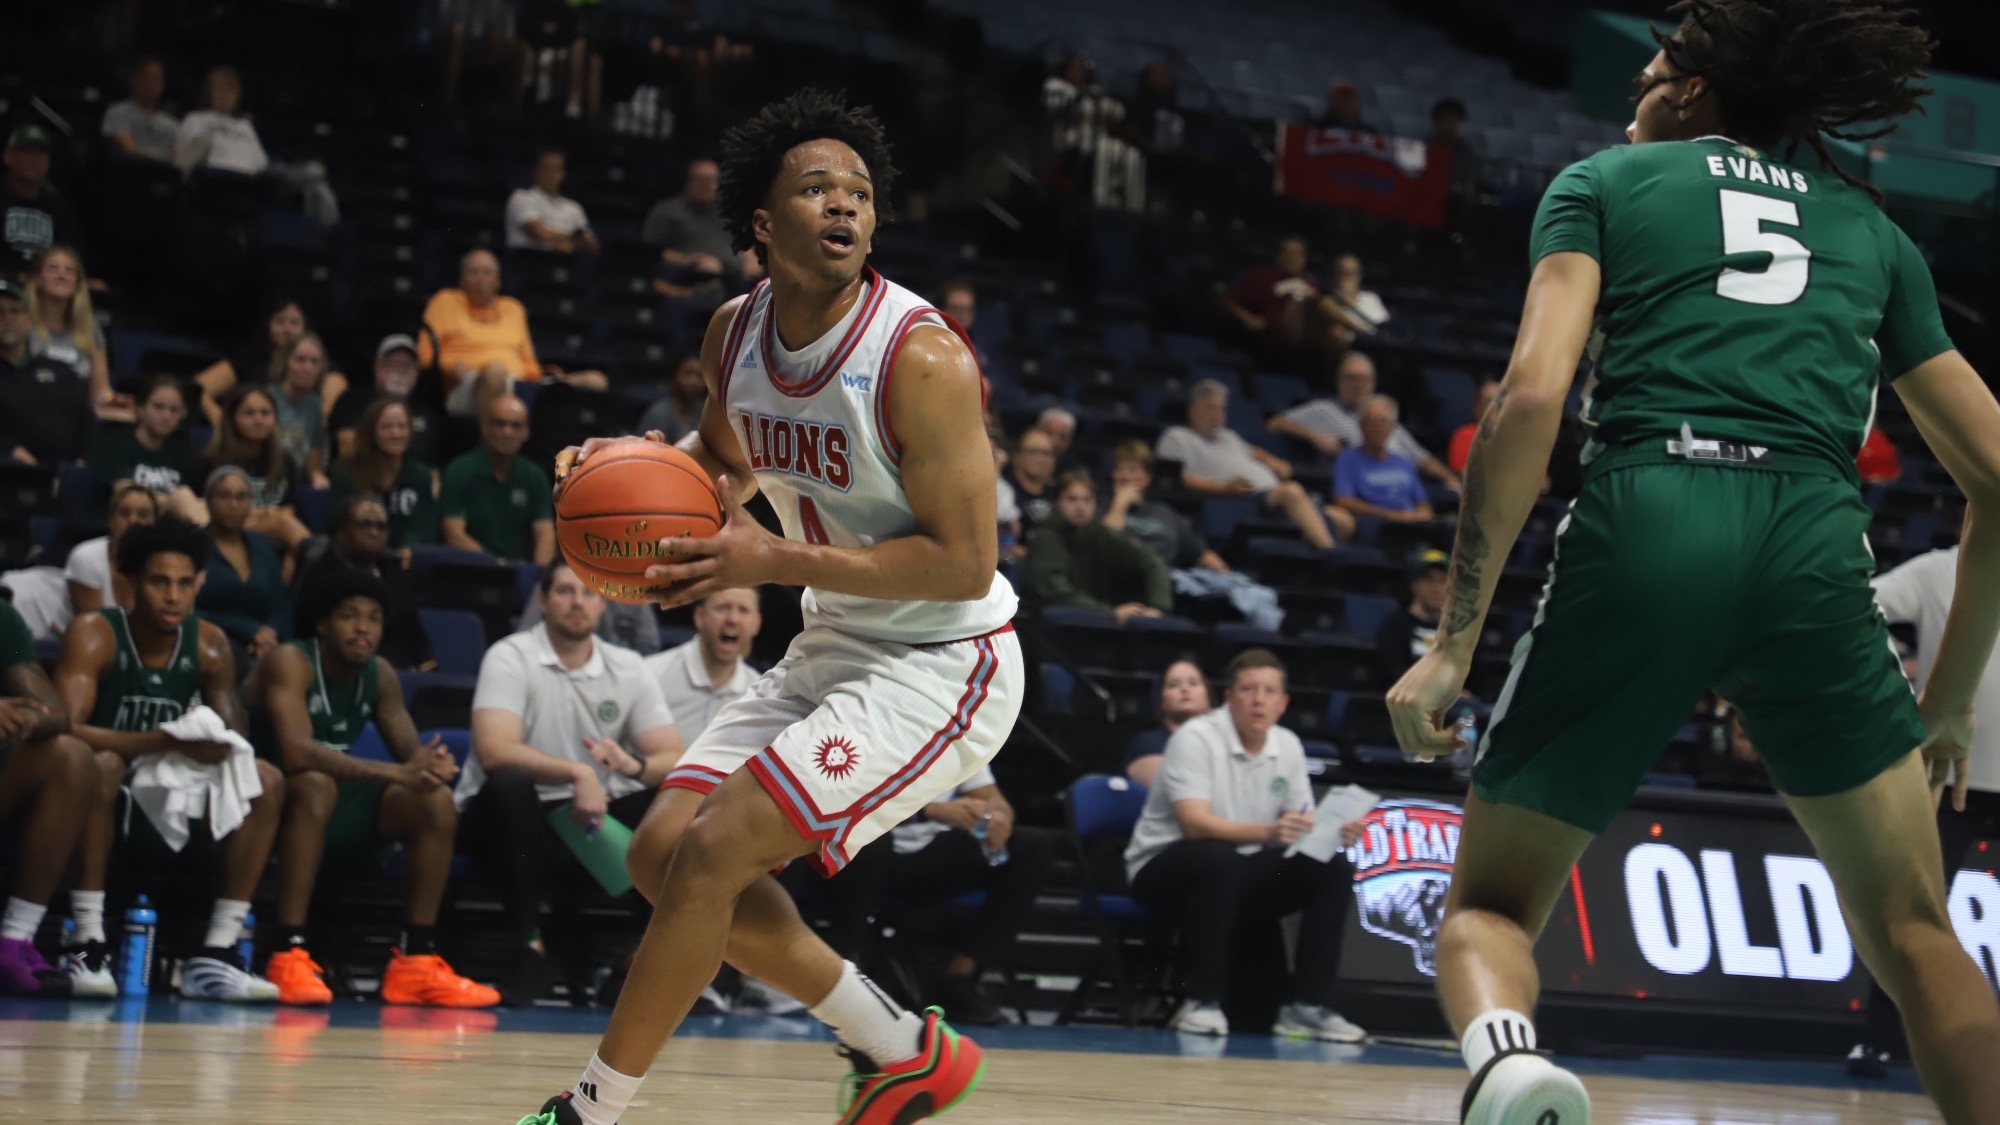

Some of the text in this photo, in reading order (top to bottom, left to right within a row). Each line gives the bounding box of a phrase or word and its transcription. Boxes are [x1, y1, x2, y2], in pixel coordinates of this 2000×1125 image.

[1706, 156, 1809, 193] EVANS
[1716, 188, 1812, 305] 5
[739, 410, 854, 493] LIONS
[1624, 842, 1853, 982] OLD
